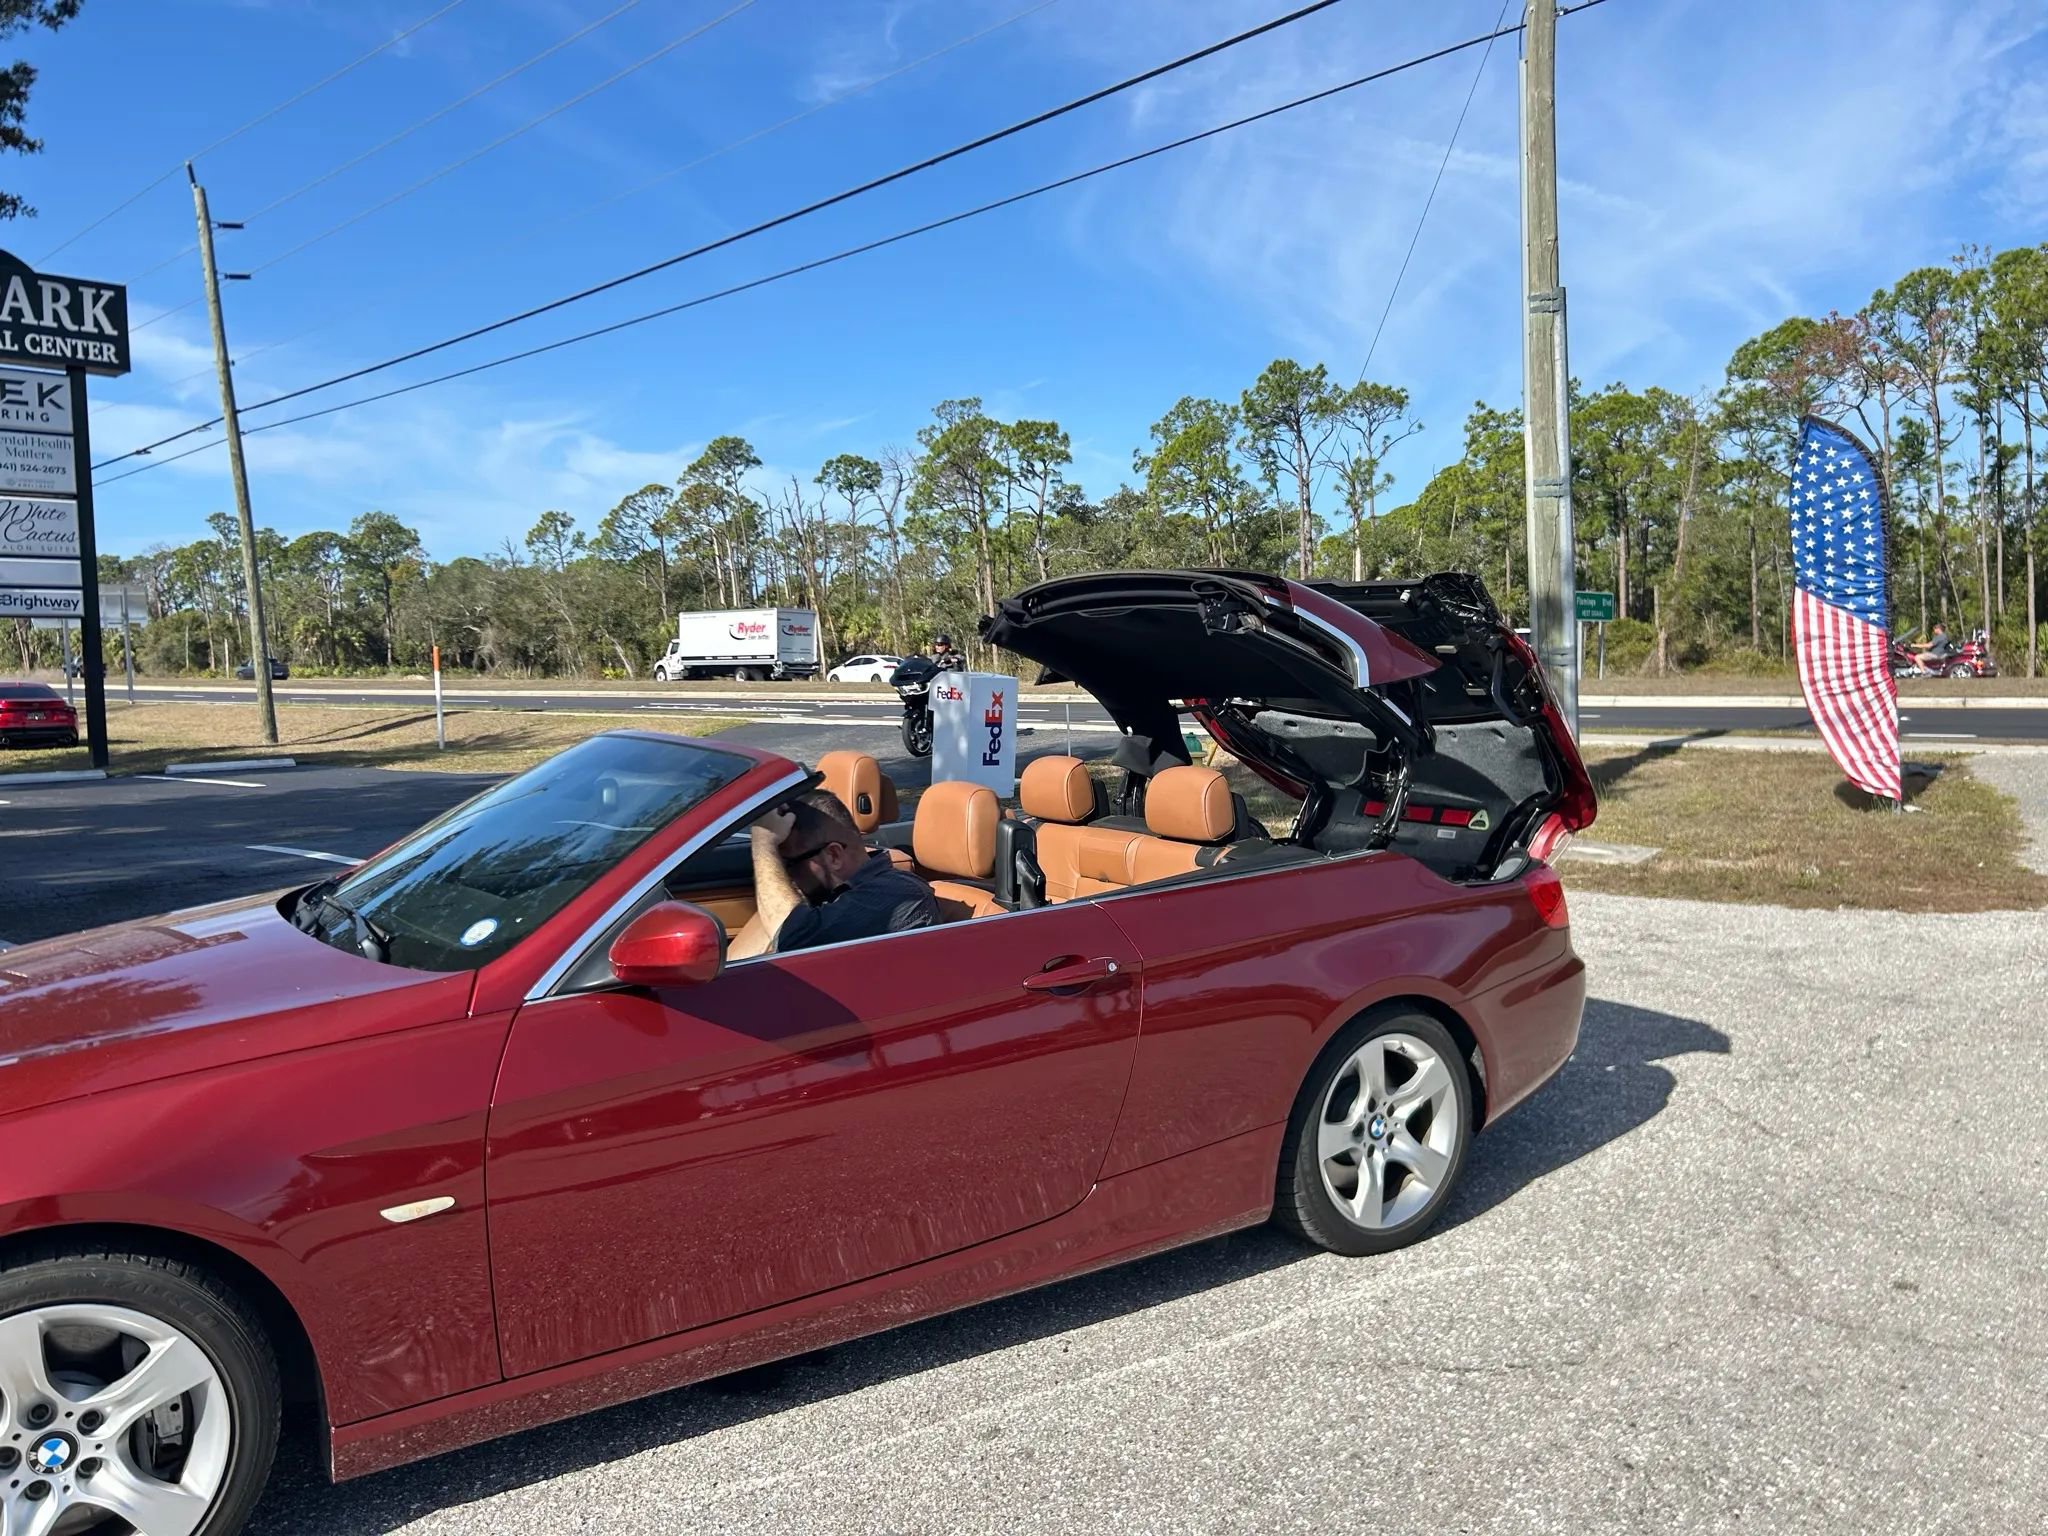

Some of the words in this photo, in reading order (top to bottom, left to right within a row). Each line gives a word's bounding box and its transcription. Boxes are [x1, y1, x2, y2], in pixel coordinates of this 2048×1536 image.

[0, 275, 118, 336] ARK
[0, 330, 19, 351] L
[24, 333, 119, 364] CENTER
[2, 409, 50, 423] RING
[31, 436, 71, 450] Health
[6, 446, 53, 460] Matters
[0, 499, 67, 525] White
[4, 519, 76, 543] Cactus
[1, 594, 80, 612] Brightway
[737, 622, 767, 636] Ryder
[787, 624, 811, 633] Ryder
[936, 686, 963, 701] FedEx
[982, 690, 1004, 766] FedEx
